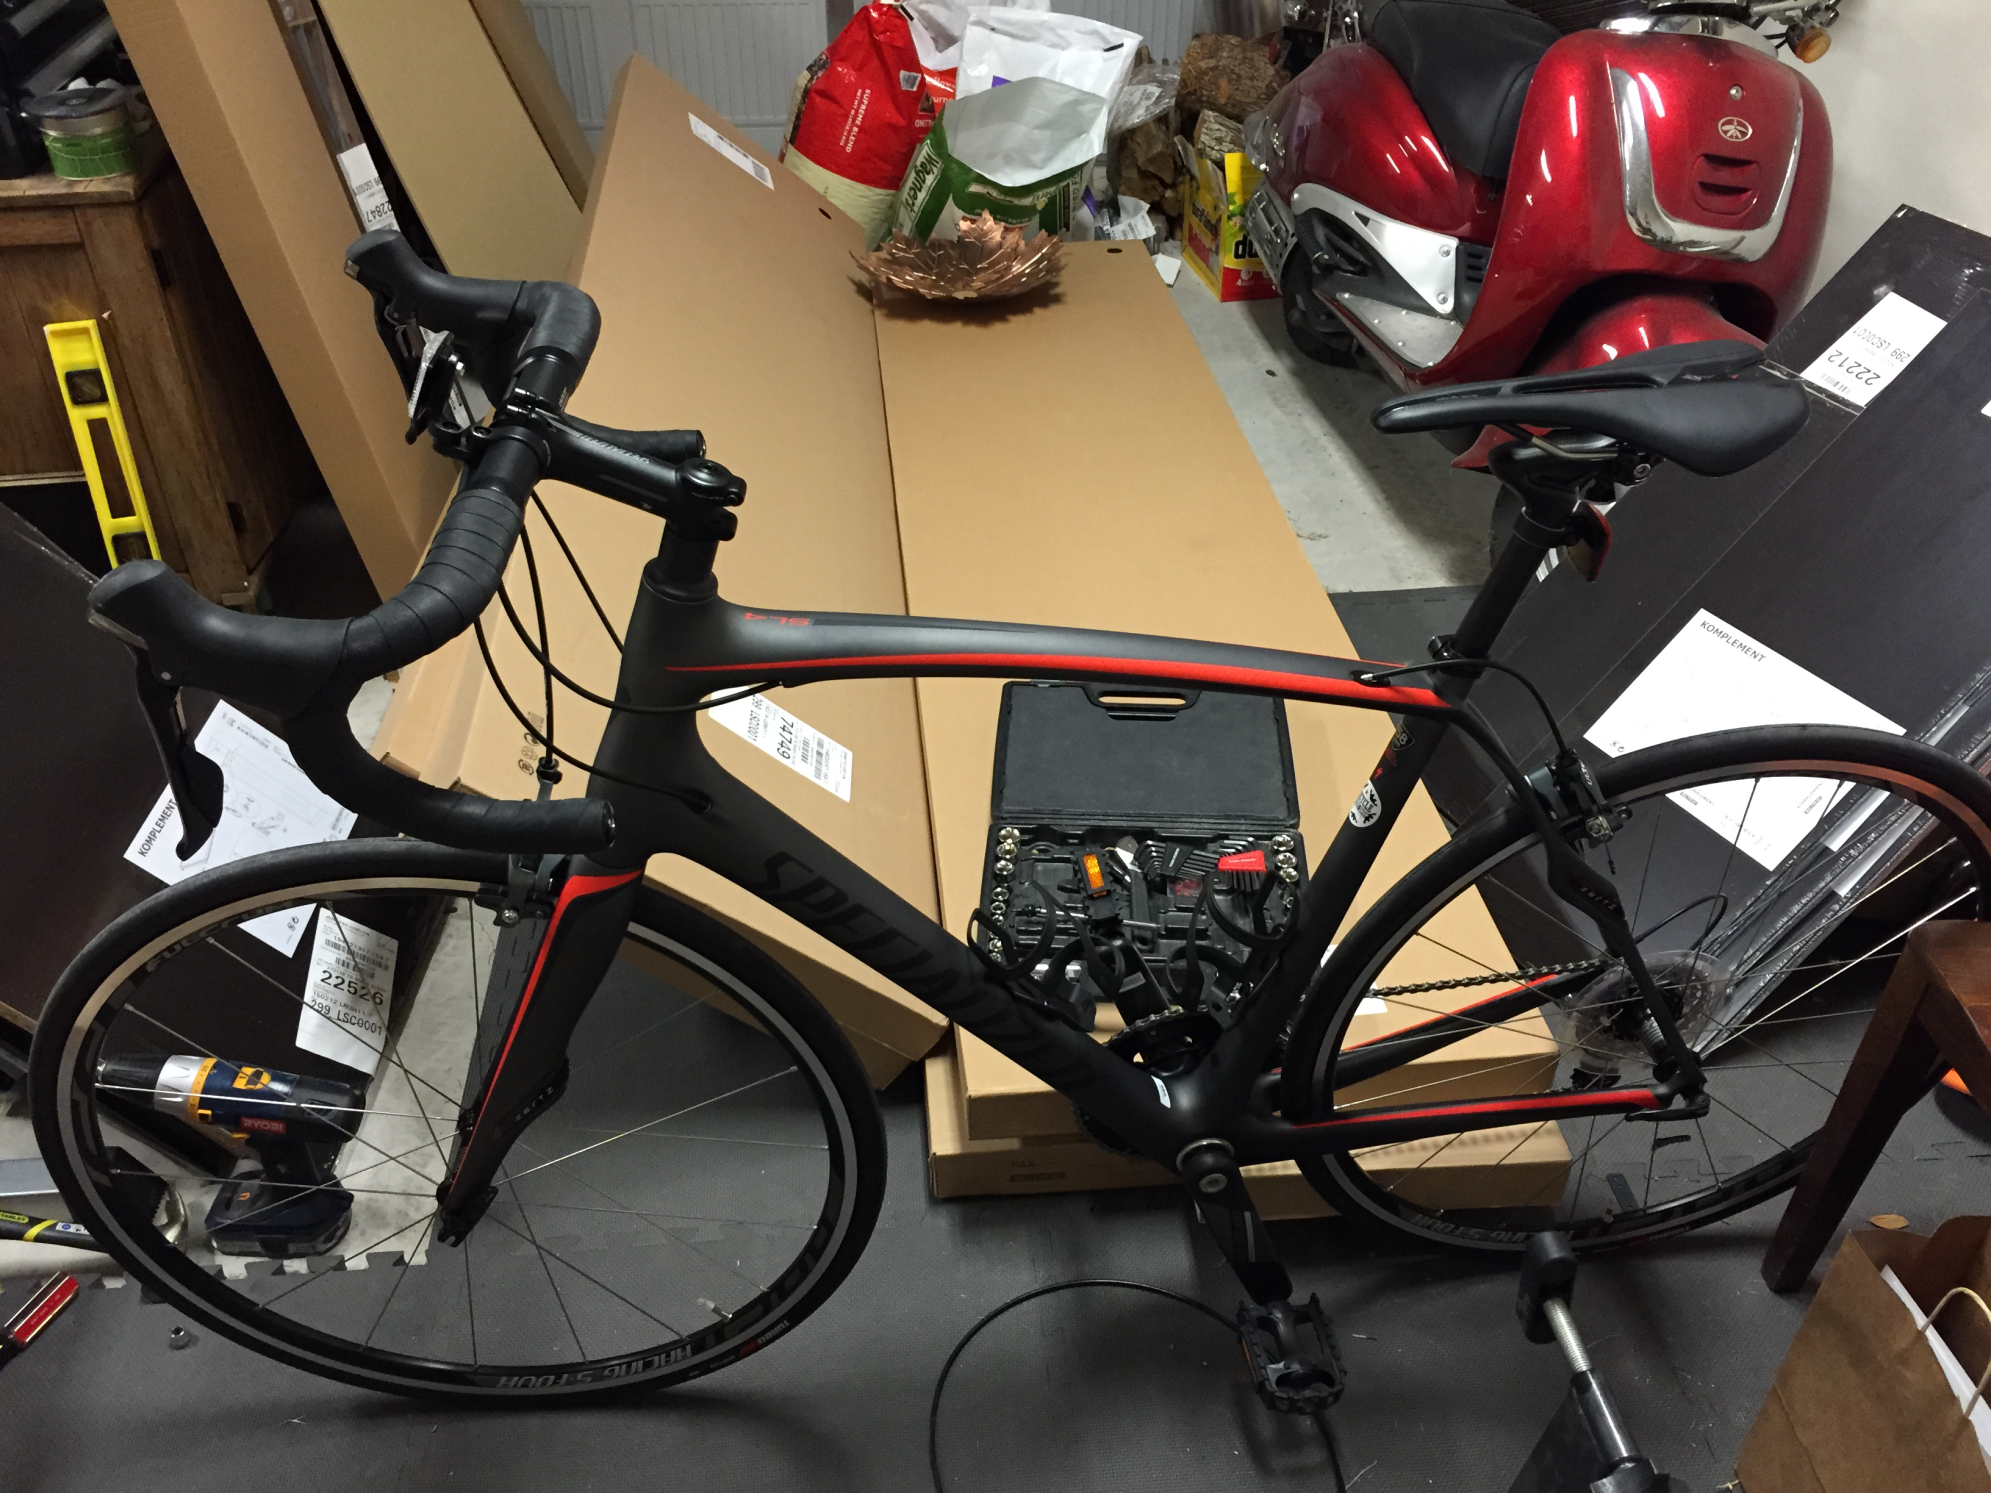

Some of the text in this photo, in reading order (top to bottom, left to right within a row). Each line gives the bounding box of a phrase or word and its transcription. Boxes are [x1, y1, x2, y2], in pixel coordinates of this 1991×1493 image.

[855, 89, 871, 125] SUPREME
[914, 119, 934, 128] LEND
[845, 126, 858, 153] BLEND
[365, 200, 393, 224] 22847
[1852, 326, 1891, 352] LSC0001
[1890, 347, 1911, 363] 299
[1827, 349, 1881, 386] 22212
[1700, 620, 1766, 664] KOMPLEMENT
[747, 693, 764, 742] 299 LSC0001
[776, 716, 795, 761] 74749
[138, 798, 178, 858] KOMPLEMENT
[320, 969, 384, 1006] 22526
[310, 999, 382, 1036] 299 LSC0001
[242, 1119, 284, 1132] RYOBI
[0, 1212, 26, 1222] TANLEY
[603, 1343, 692, 1379] RACING
